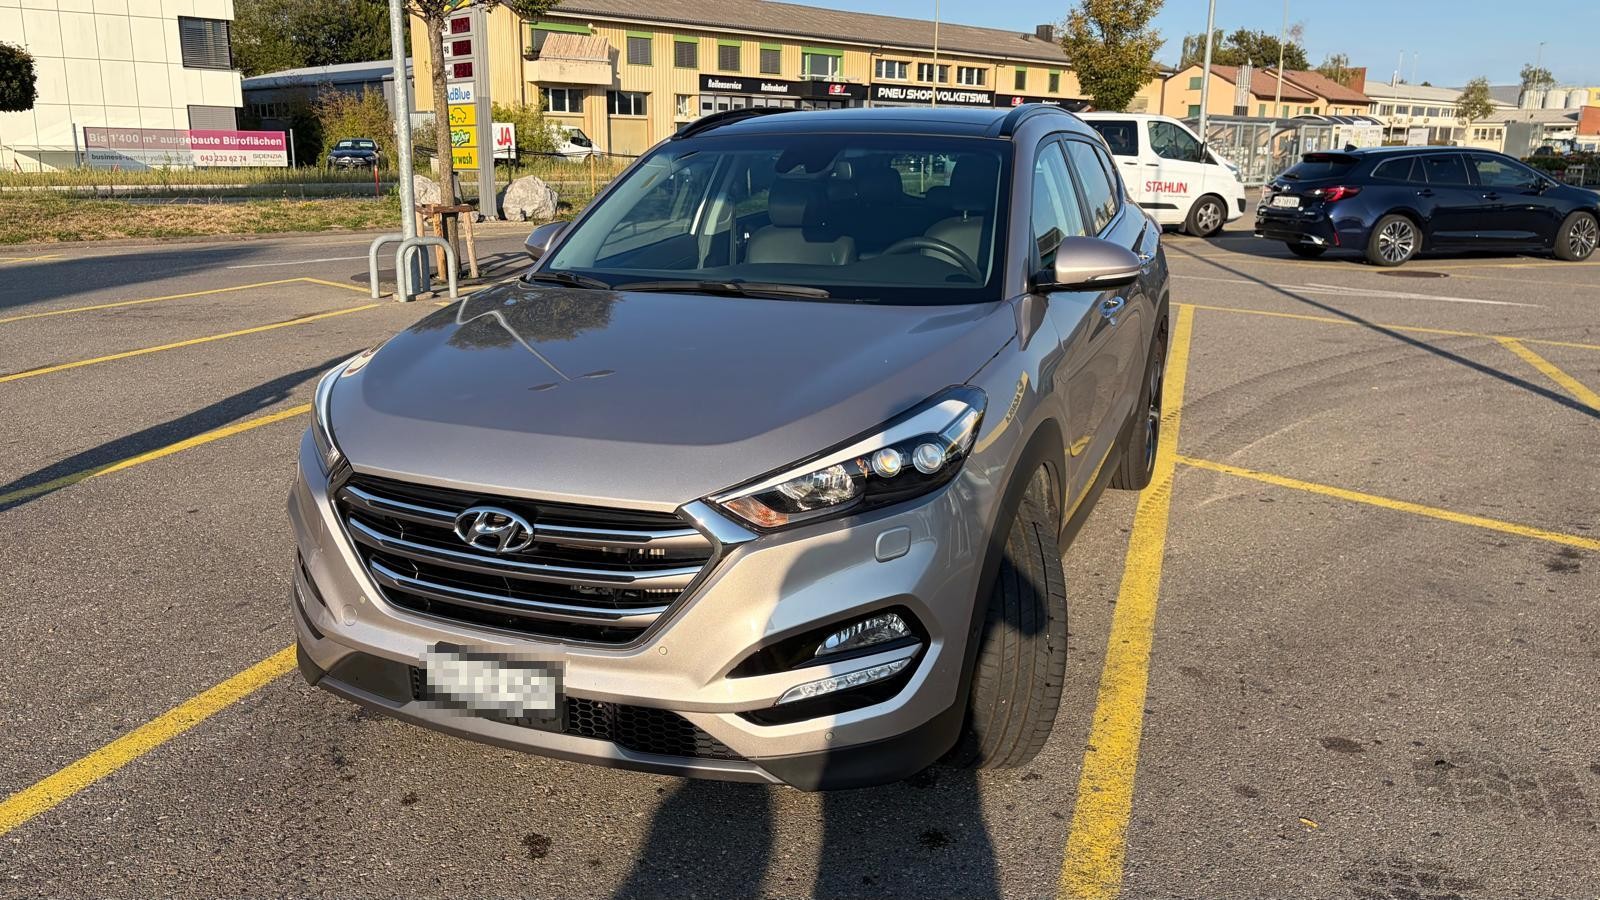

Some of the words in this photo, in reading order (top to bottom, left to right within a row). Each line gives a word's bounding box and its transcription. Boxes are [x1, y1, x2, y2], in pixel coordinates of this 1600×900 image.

[878, 87, 906, 99] PNEU
[906, 89, 933, 101] SHOP
[936, 91, 991, 104] VOLKETSWIL
[88, 133, 107, 143] Bis
[110, 134, 140, 143] 1'400
[160, 135, 221, 146] ausgebaute
[223, 136, 282, 146] Büroflächen
[497, 127, 513, 146] JA
[200, 154, 213, 162] 043
